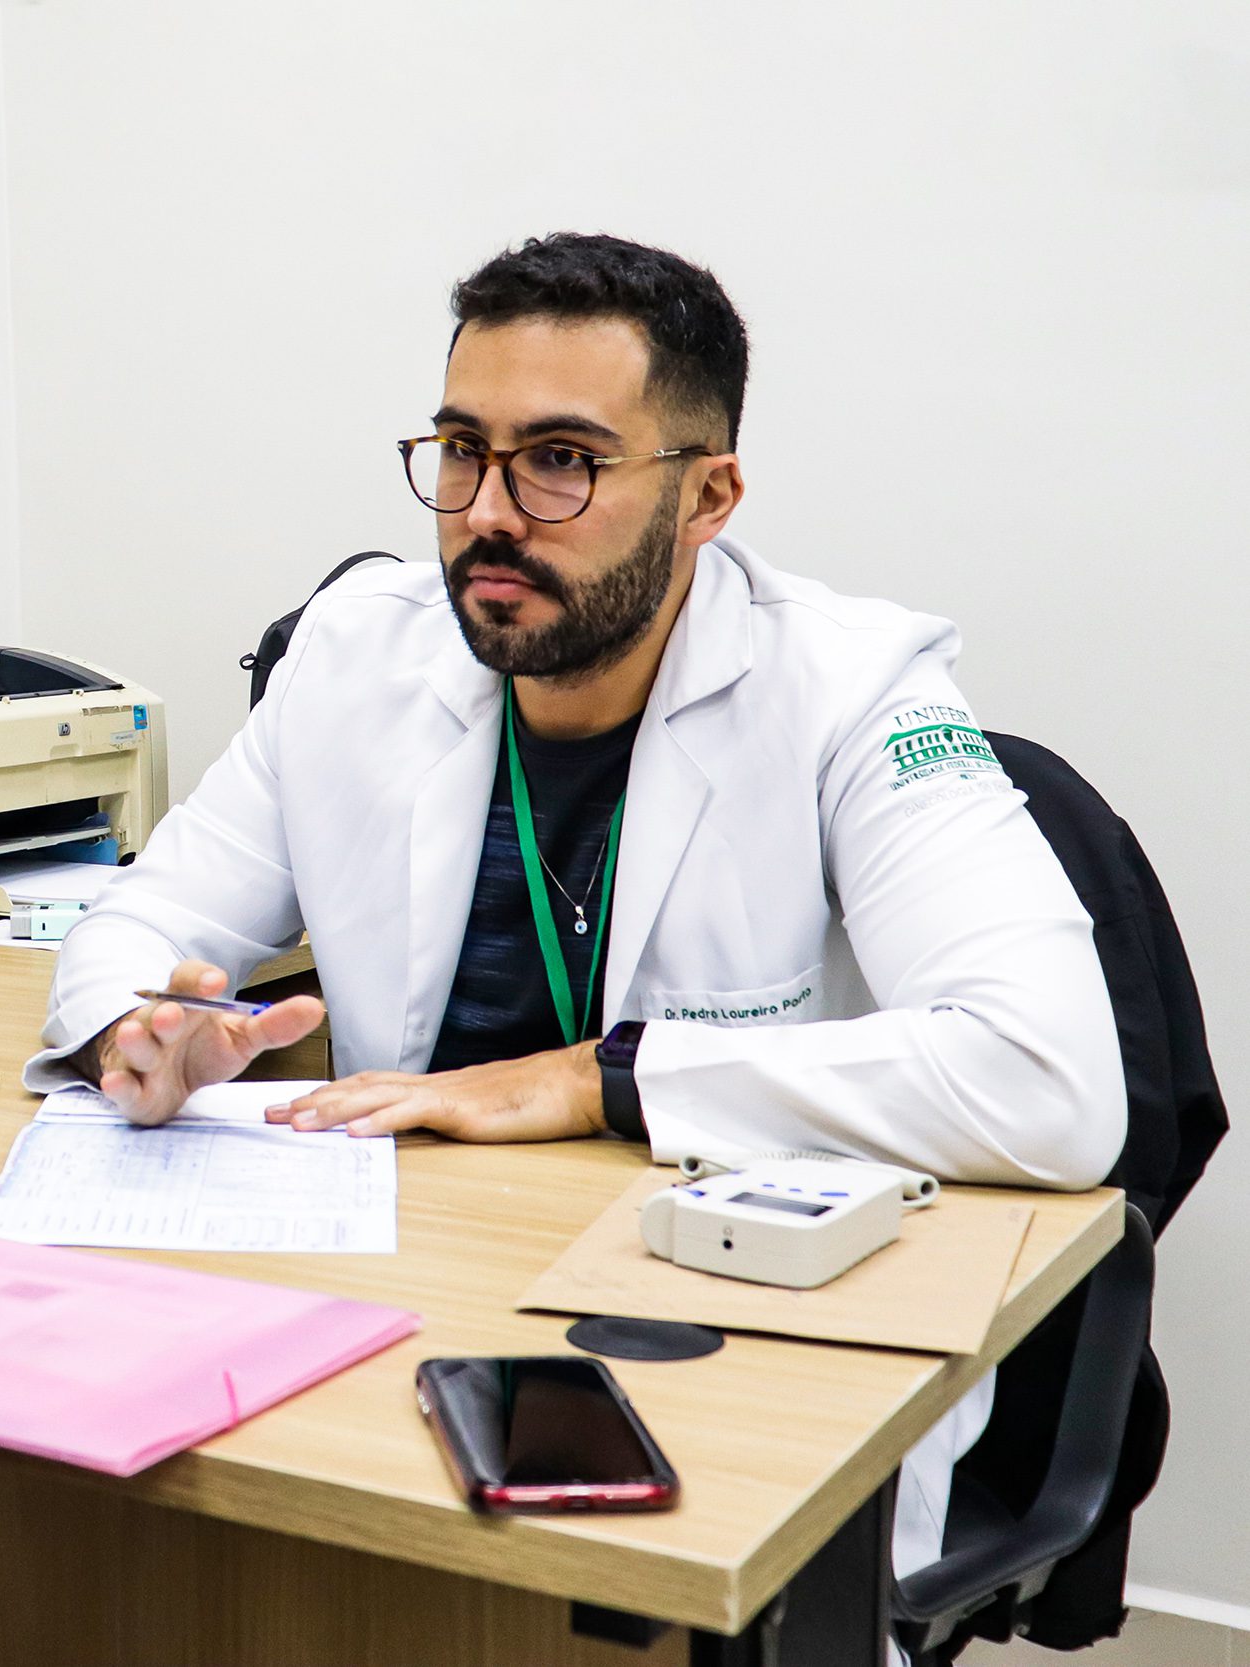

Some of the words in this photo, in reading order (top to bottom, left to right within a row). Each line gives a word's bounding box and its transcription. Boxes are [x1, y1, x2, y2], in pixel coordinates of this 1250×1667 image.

[664, 1008, 680, 1020] Dr.
[681, 1007, 719, 1020] Pedro
[721, 1005, 778, 1019] Loureiro
[782, 987, 812, 1011] Porto
